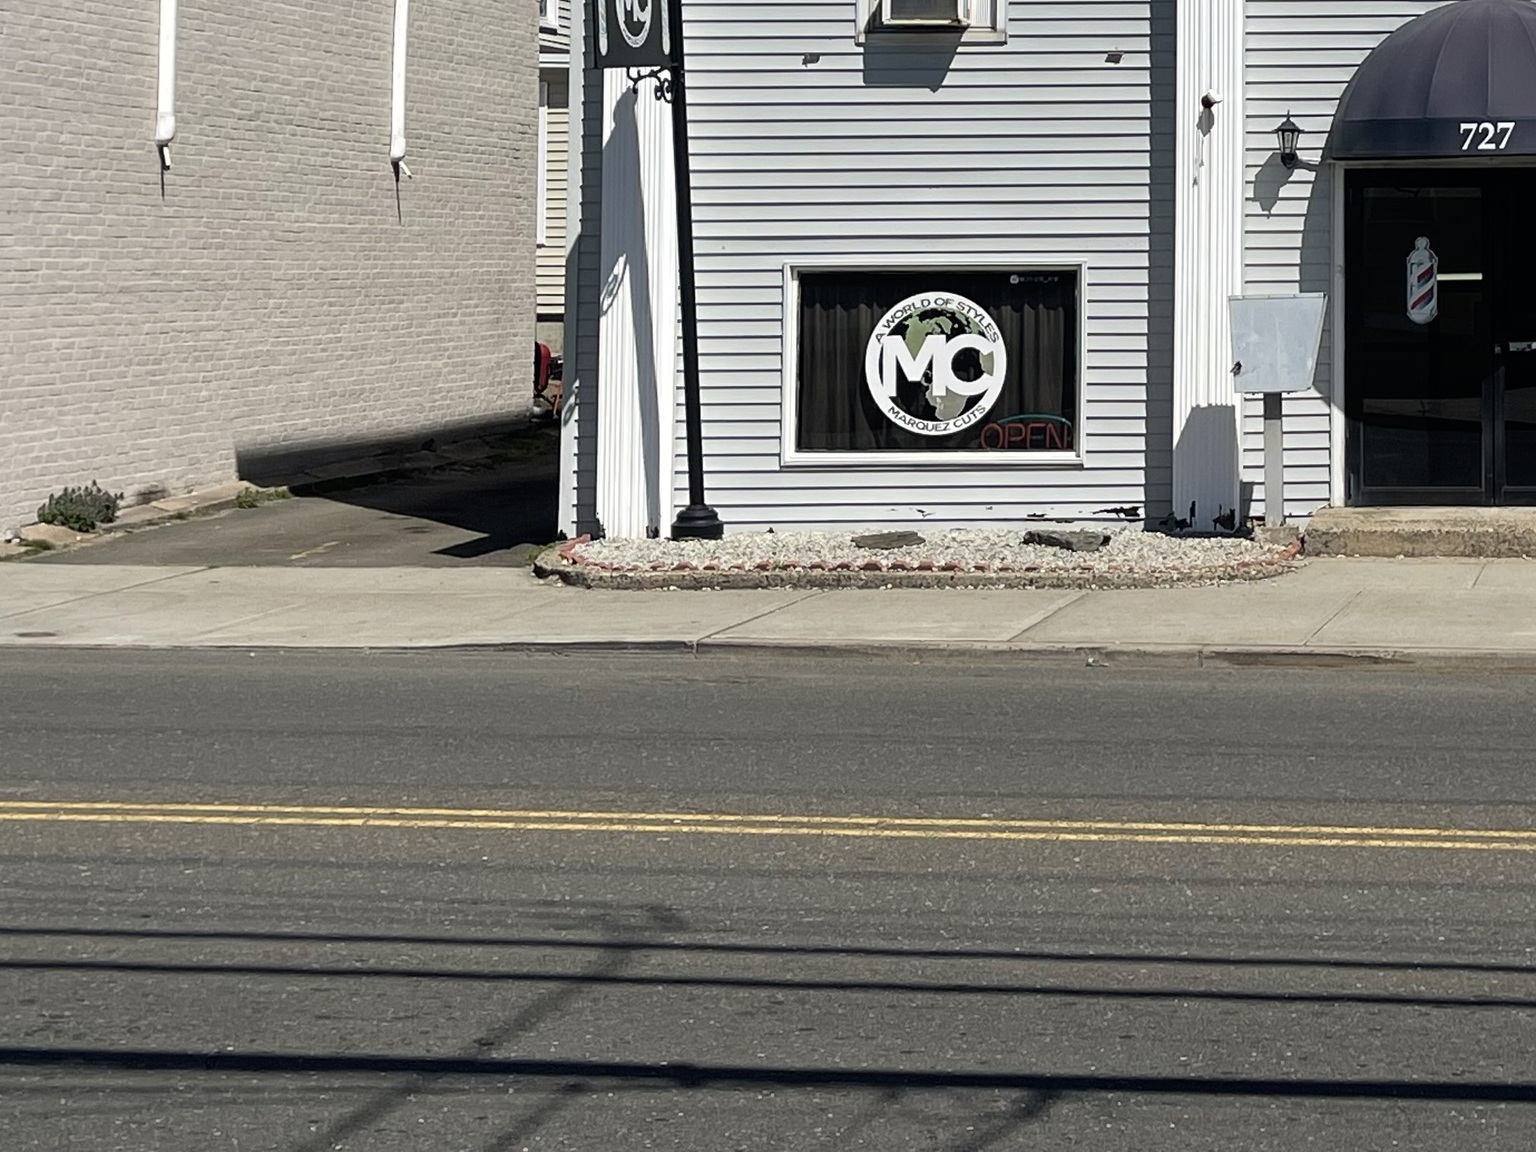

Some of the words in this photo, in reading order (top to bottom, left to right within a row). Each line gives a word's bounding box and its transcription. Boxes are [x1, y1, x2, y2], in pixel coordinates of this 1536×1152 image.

[1458, 122, 1516, 151] 727
[875, 332, 887, 344] A
[882, 298, 931, 329] WORLD
[934, 297, 956, 306] OF
[956, 301, 1000, 344] STYLES
[882, 333, 995, 397] MC
[887, 405, 951, 432] MARQUEZ
[953, 404, 987, 428] CUTS
[980, 421, 1073, 449] OPEN
